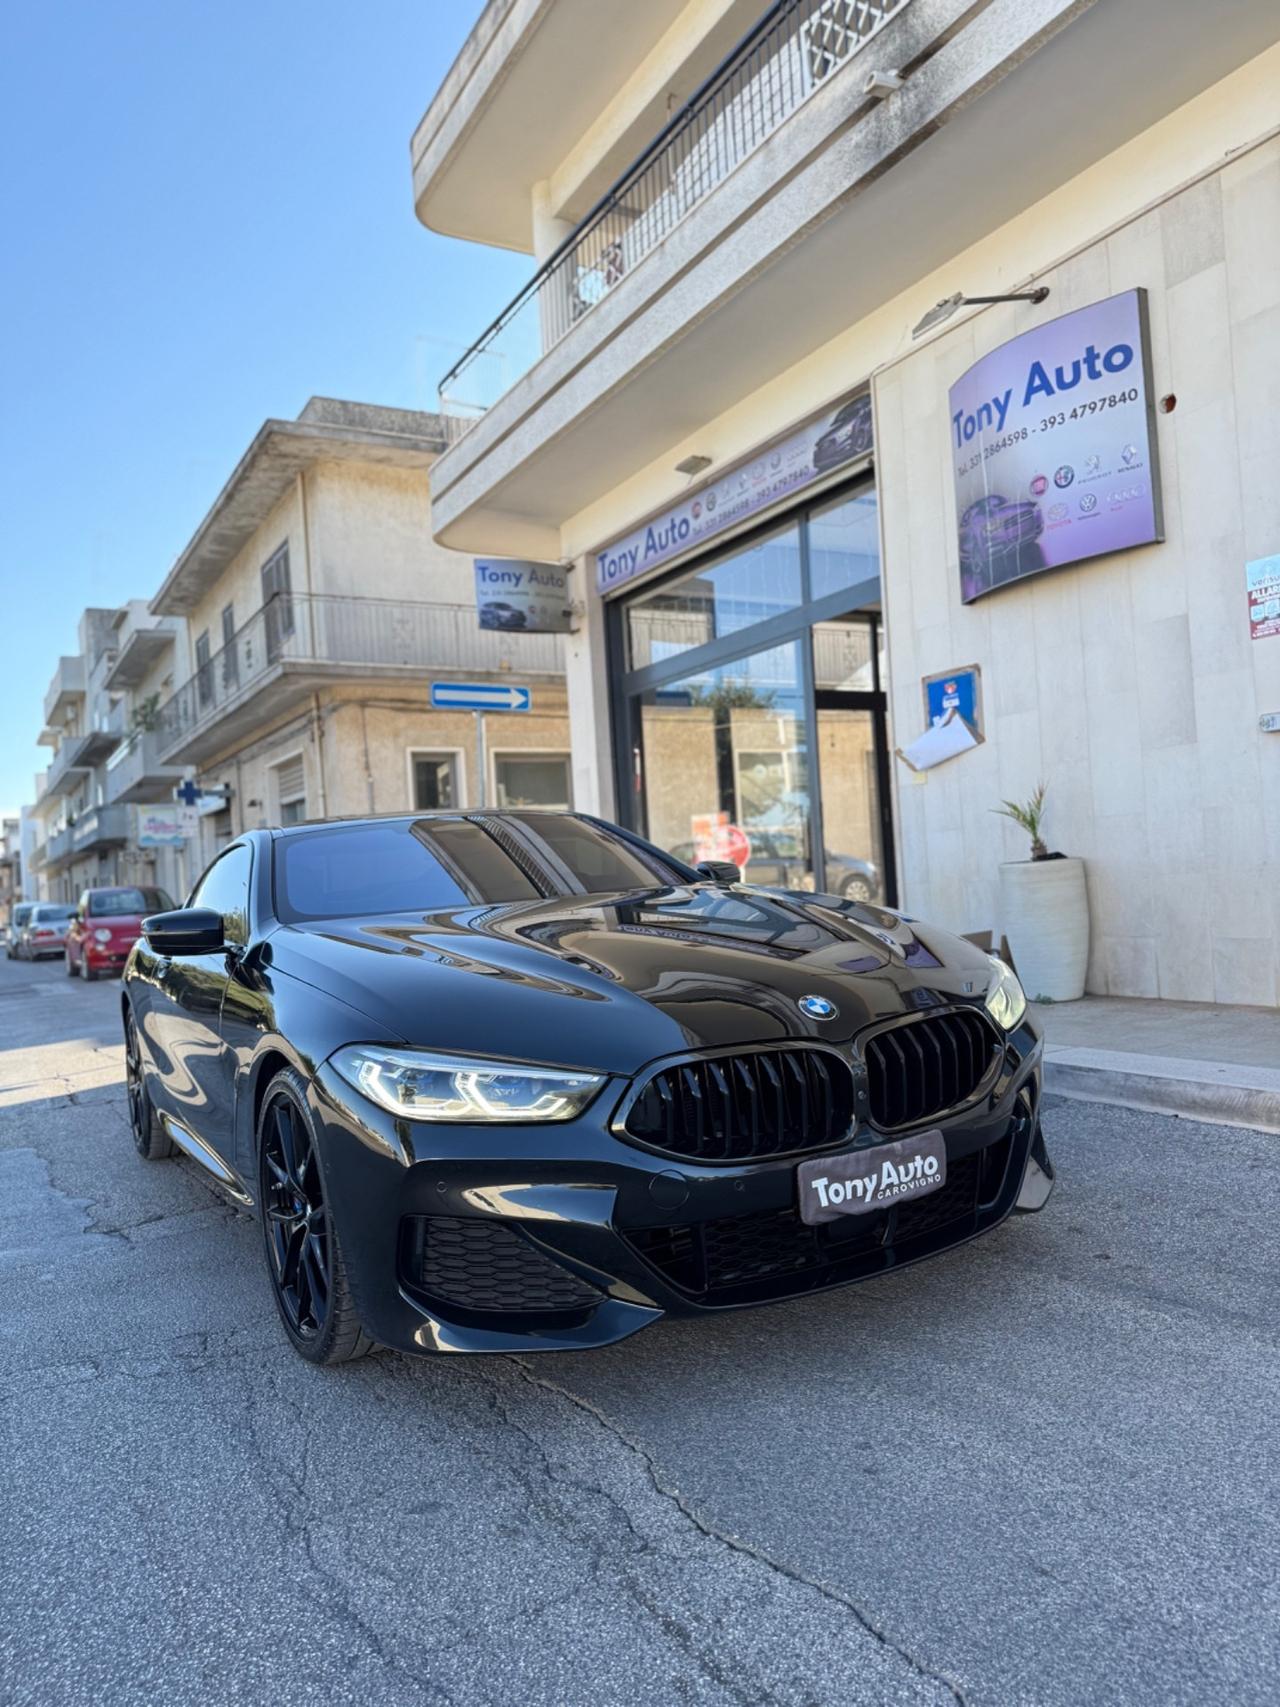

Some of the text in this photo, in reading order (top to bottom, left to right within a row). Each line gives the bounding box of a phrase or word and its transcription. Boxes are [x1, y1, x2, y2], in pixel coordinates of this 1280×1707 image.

[953, 344, 1134, 449] Tony Auto
[983, 427, 1028, 460] 2864598
[1040, 412, 1065, 432] 393
[1069, 388, 1138, 420] 4797840
[478, 566, 565, 588] Tony Auto
[598, 516, 690, 583] Tony Auto
[877, 1174, 941, 1200] CAROVIGNO
